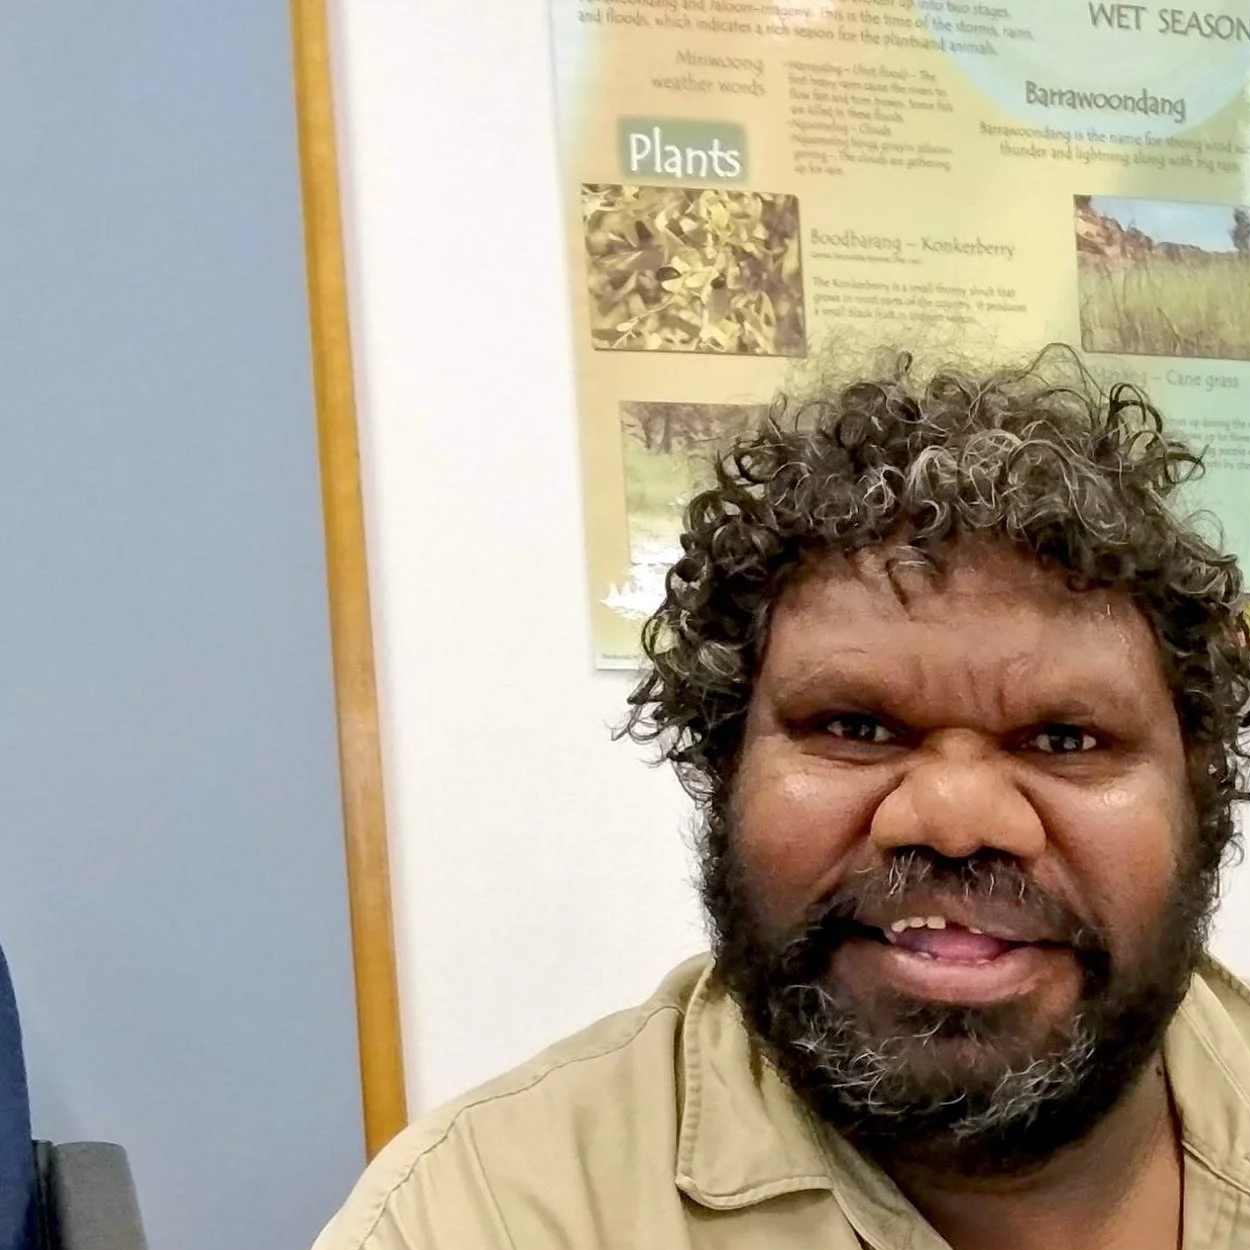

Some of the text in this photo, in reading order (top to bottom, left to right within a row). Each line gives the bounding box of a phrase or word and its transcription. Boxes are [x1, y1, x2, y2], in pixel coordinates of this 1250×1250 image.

[578, 8, 602, 25] and
[655, 12, 692, 30] which
[696, 16, 752, 35] indicates
[794, 26, 834, 40] season
[838, 24, 857, 41] for
[860, 28, 881, 45] the
[883, 13, 913, 28] time
[1088, 2, 1149, 32] WET
[651, 71, 767, 97] weather words
[1025, 79, 1186, 124] Barrawoondang
[1086, 125, 1107, 144] the
[1109, 133, 1142, 148] name
[1144, 130, 1163, 148] for
[629, 125, 743, 181] Plants
[999, 139, 1047, 161] thunder
[1050, 145, 1073, 161] and
[920, 235, 1016, 261] Konkerberry
[1166, 368, 1203, 388] Cane
[1204, 374, 1241, 393] grass
